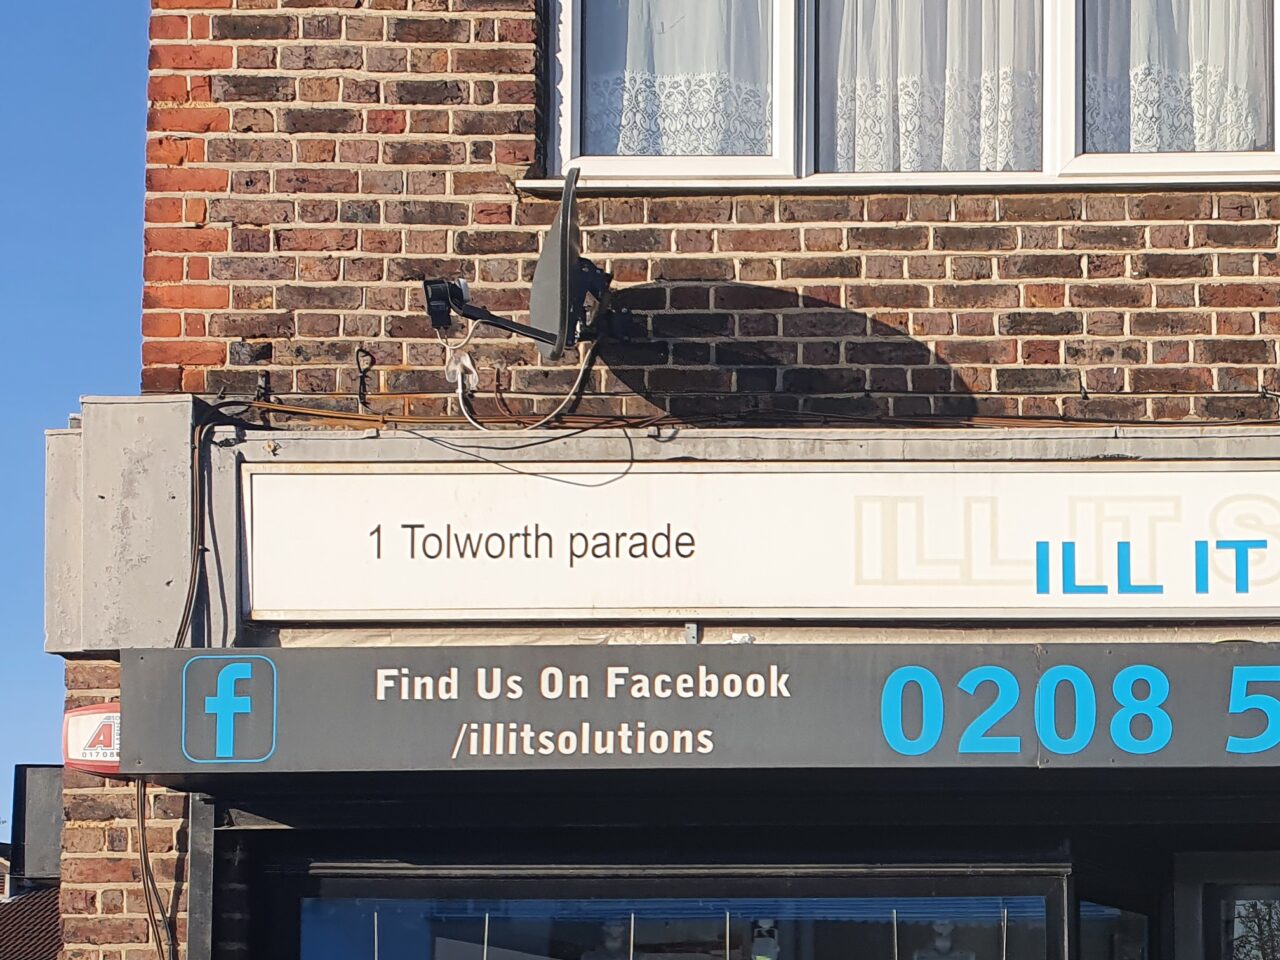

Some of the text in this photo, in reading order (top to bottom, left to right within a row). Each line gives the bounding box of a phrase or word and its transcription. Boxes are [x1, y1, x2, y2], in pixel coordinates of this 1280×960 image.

[370, 523, 696, 567] 1 Tolworth parade
[1035, 539, 1165, 594] ILL
[1195, 539, 1268, 594] IT
[375, 665, 792, 701] Find Us On Facebook
[880, 663, 1173, 756] 0208
[450, 722, 715, 758] /illitsolutions
